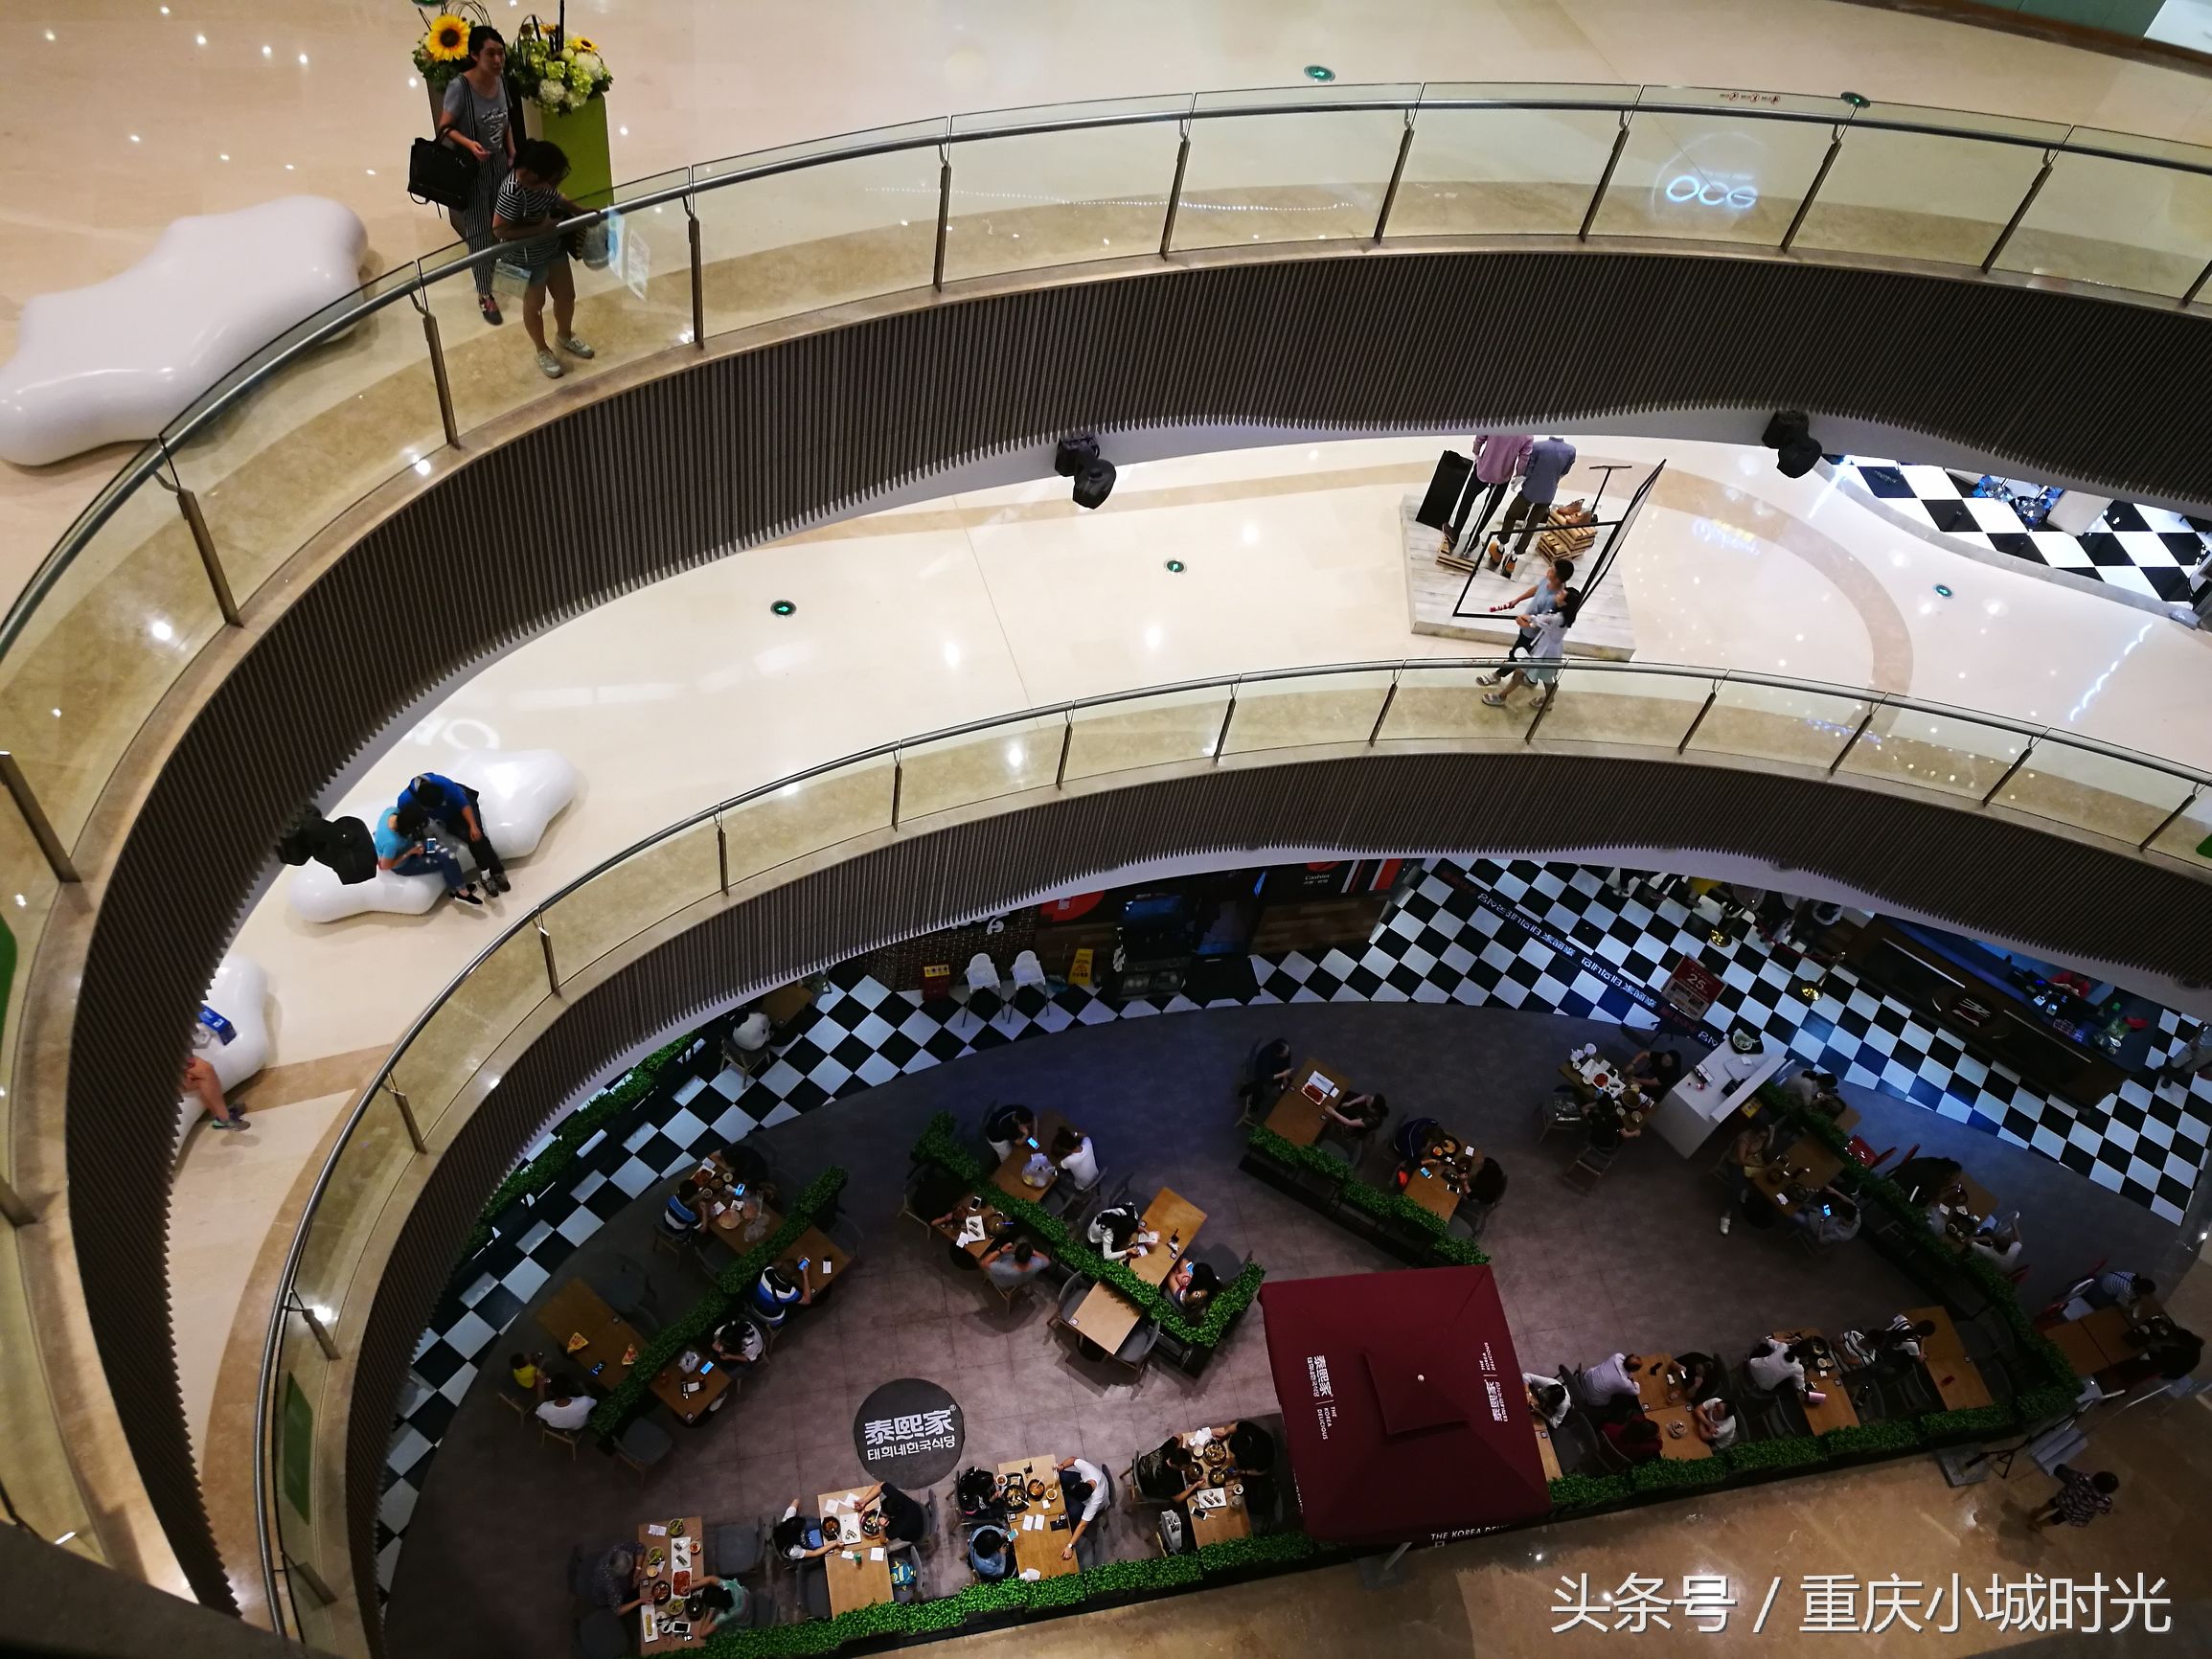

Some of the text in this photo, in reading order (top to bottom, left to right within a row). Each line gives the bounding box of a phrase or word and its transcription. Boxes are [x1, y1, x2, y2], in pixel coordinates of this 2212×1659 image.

[1686, 973, 1707, 990] 25
[1313, 1354, 1333, 1398] 泰熙家
[864, 1409, 955, 1446] 泰熙家
[1316, 1409, 1329, 1440] DELICIOUS
[1323, 1407, 1333, 1427] KOREA
[866, 1434, 956, 1462] 태희네한국식당
[1430, 1532, 1448, 1541] THE
[1451, 1528, 1481, 1538] KOREA
